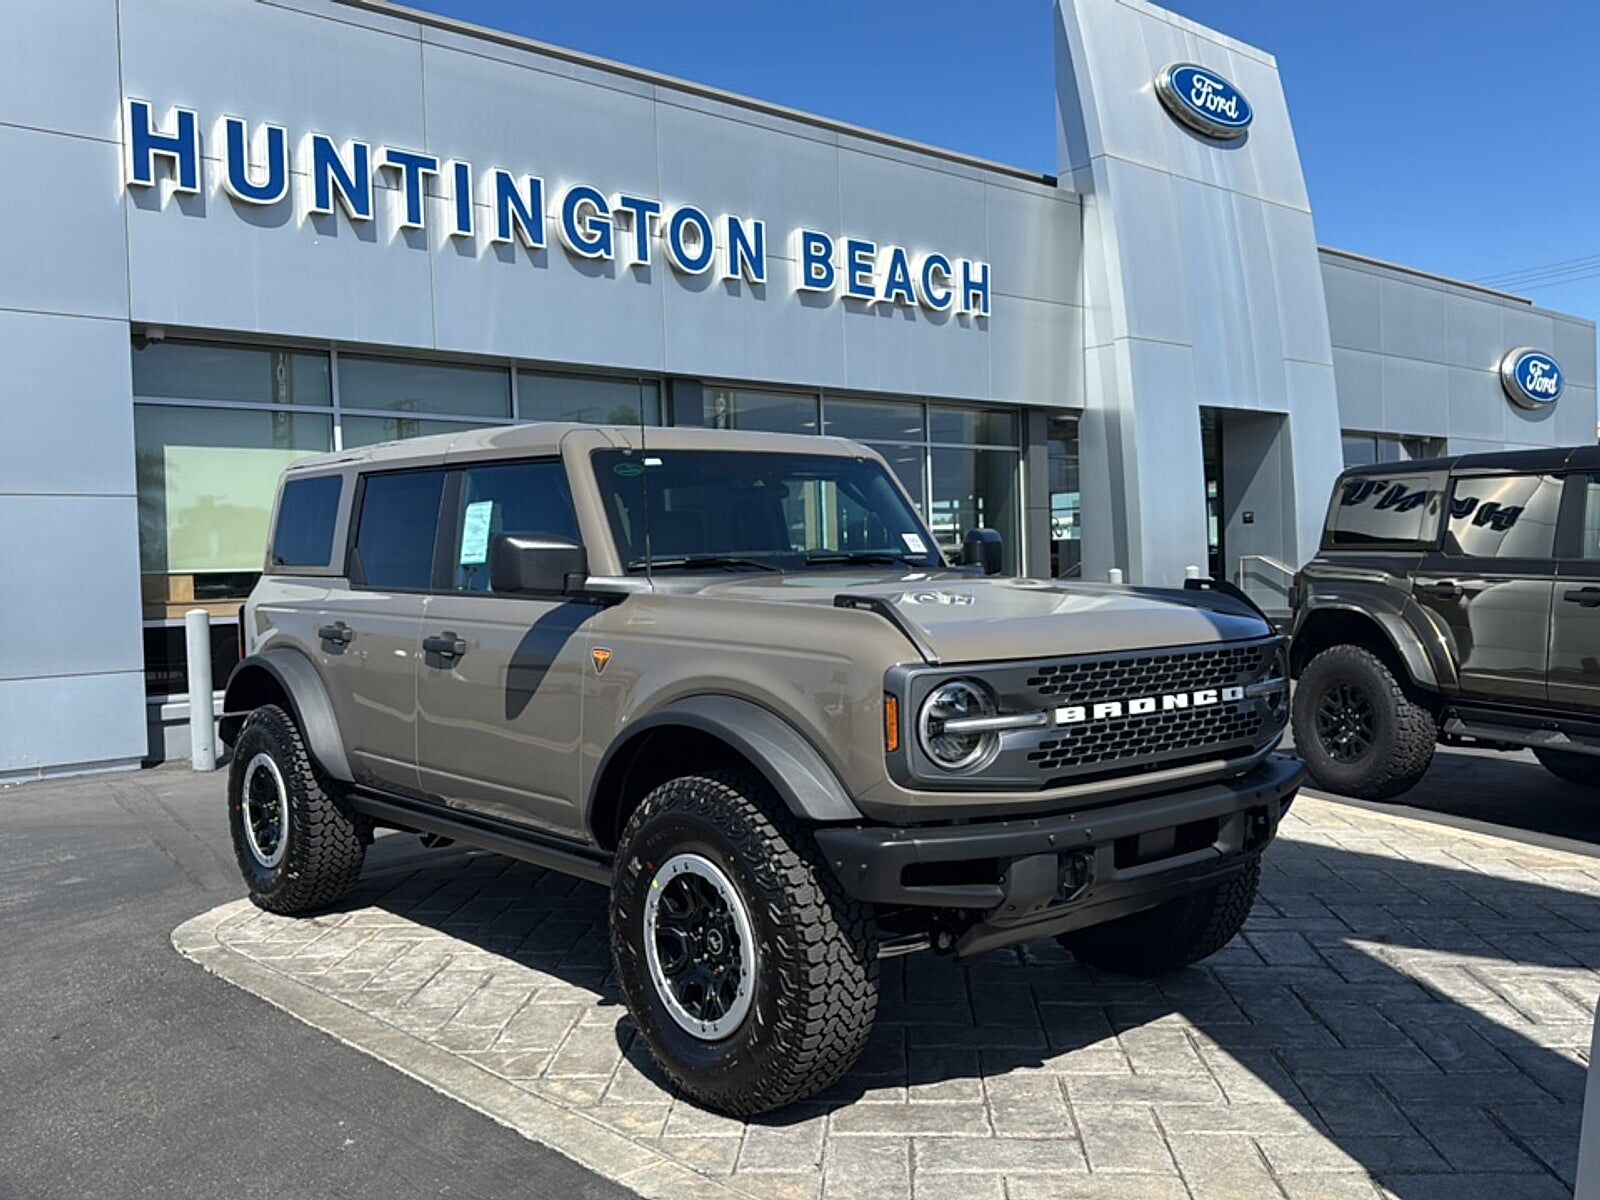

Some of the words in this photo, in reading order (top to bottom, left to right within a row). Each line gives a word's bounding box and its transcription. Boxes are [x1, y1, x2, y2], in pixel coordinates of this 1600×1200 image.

[1191, 74, 1239, 119] Ford
[128, 98, 767, 282] HUNTINGTON
[800, 228, 991, 316] BEACH
[1526, 360, 1558, 394] Ford
[1055, 686, 1244, 724] BRONCO
